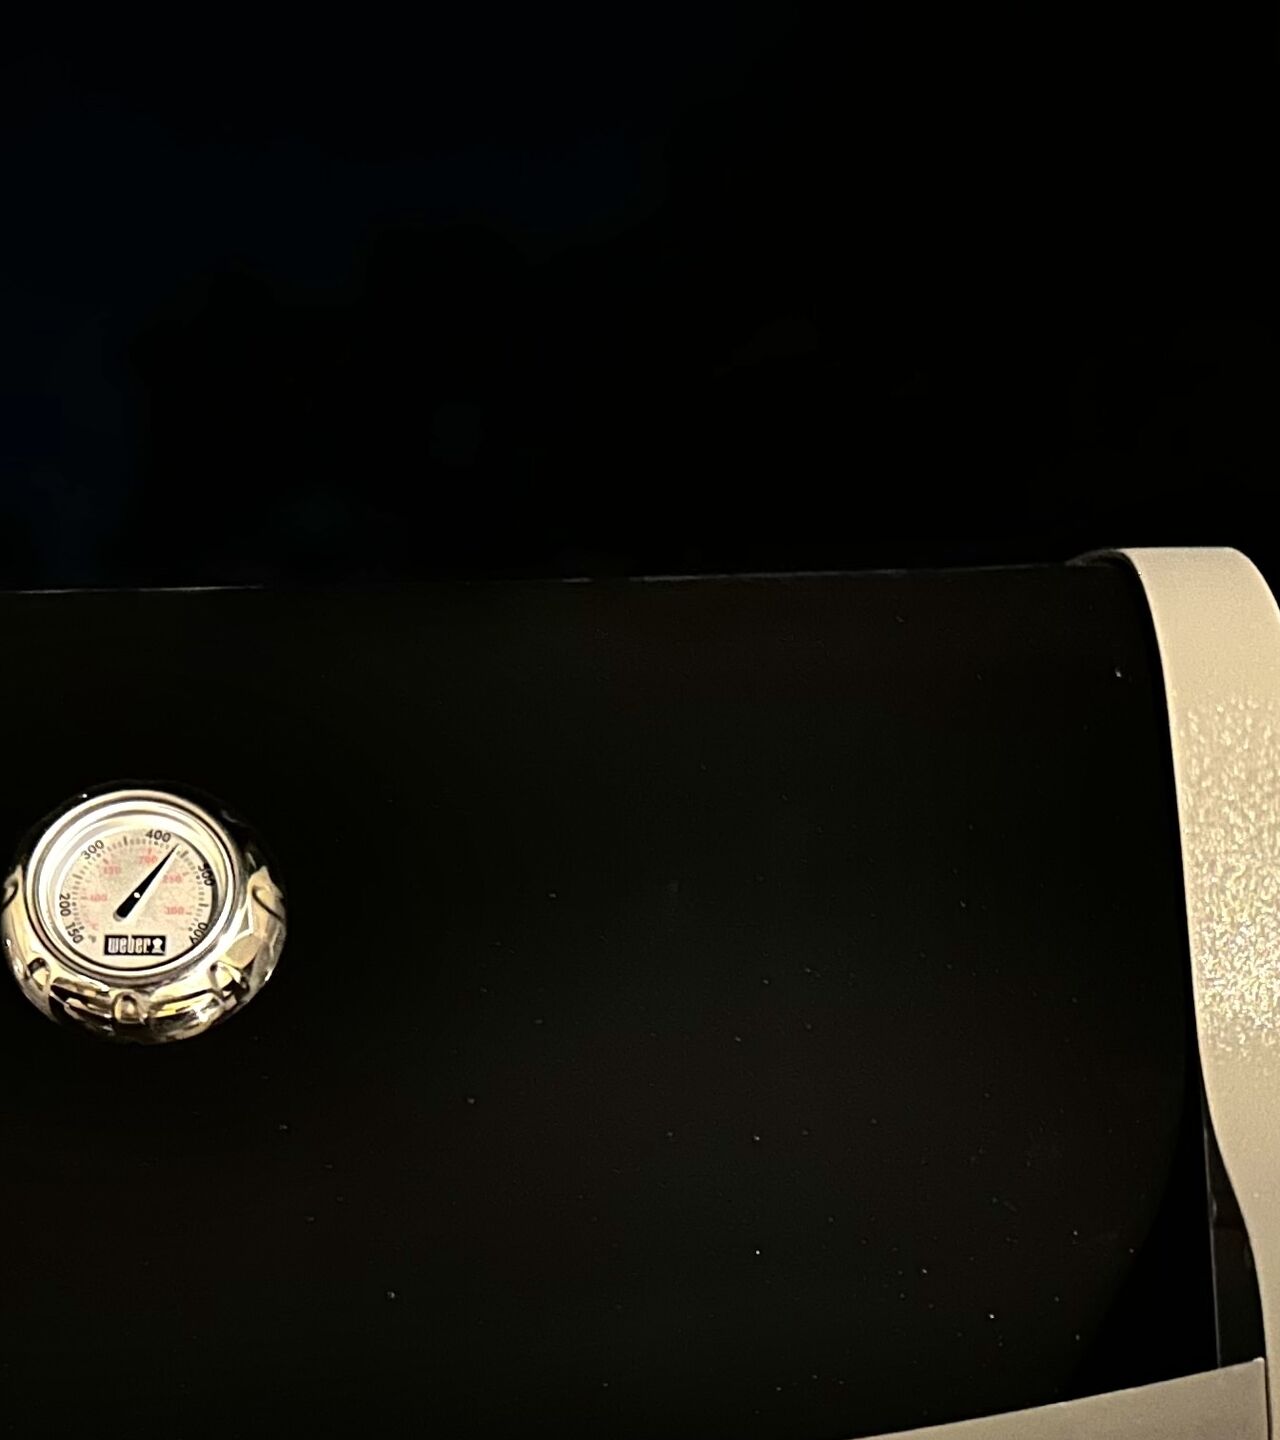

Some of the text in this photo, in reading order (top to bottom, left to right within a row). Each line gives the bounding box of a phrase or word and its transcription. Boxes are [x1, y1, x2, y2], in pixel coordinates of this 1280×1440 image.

[146, 829, 171, 842] 400
[81, 840, 105, 860] 300
[197, 862, 216, 886] 500
[59, 893, 71, 917] 200
[65, 922, 84, 944] 150
[107, 934, 151, 954] weber
